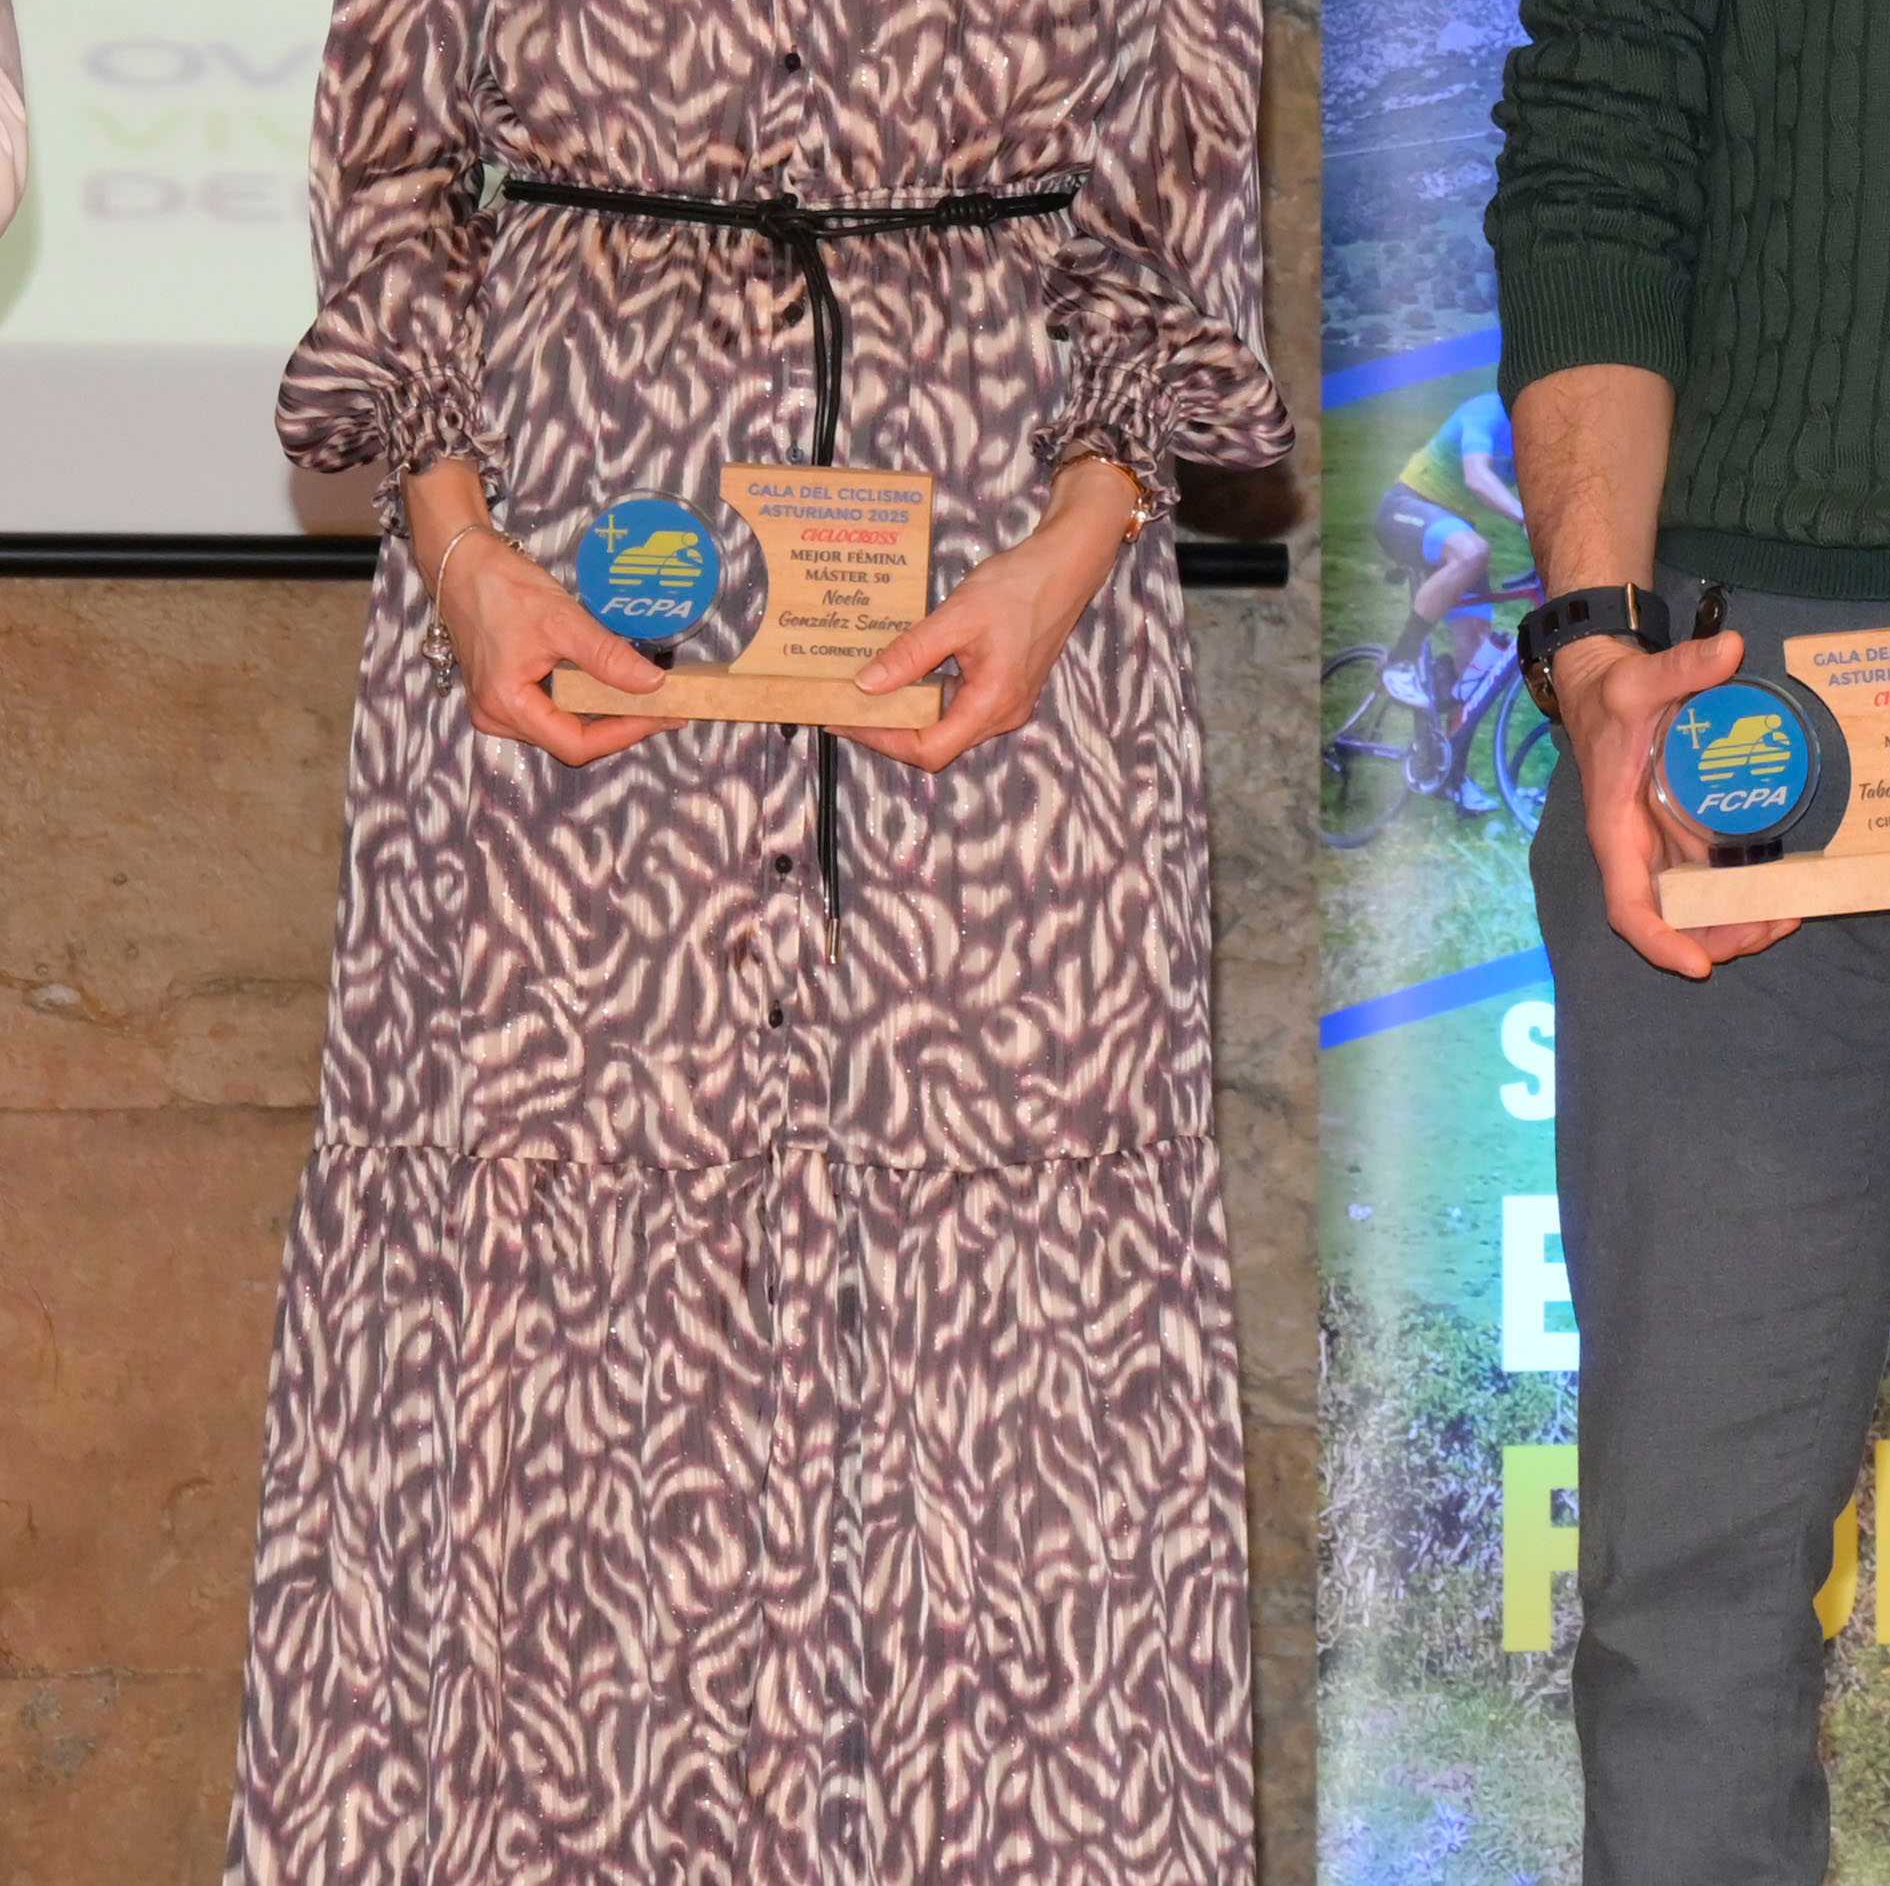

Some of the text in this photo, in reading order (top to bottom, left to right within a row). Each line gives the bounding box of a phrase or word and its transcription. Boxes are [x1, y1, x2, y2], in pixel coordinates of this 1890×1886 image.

[747, 482, 923, 504] GALA DEL CICLISMO
[760, 504, 910, 524] ASTURIANO 2025
[801, 528, 899, 545] CICLOCROSS
[790, 549, 907, 565] MEJOR FÉMINA
[805, 569, 890, 584] MÁSTER 50
[822, 589, 870, 606] Noelia
[600, 596, 694, 618] FCPA
[778, 610, 850, 630] González
[1813, 650, 1861, 666] GALA
[1697, 785, 1788, 814] FCPA
